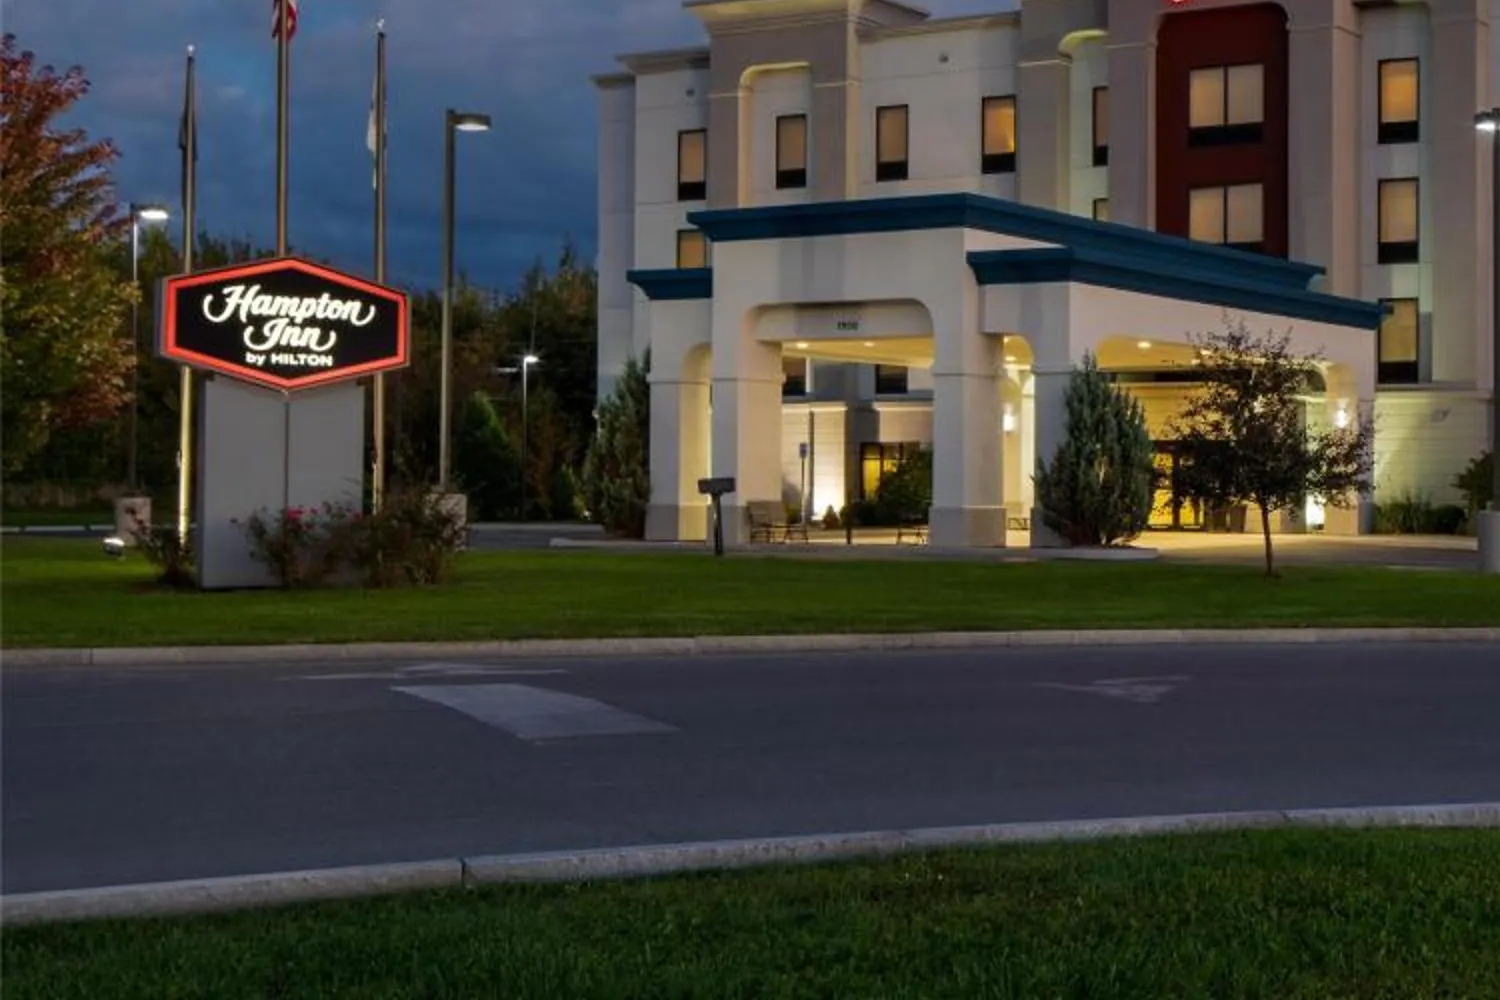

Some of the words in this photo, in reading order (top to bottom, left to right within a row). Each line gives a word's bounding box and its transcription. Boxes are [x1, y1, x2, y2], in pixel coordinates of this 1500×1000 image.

[202, 284, 376, 326] Hampton
[243, 317, 337, 351] Inn
[245, 352, 266, 366] by
[270, 353, 333, 367] HILTON
